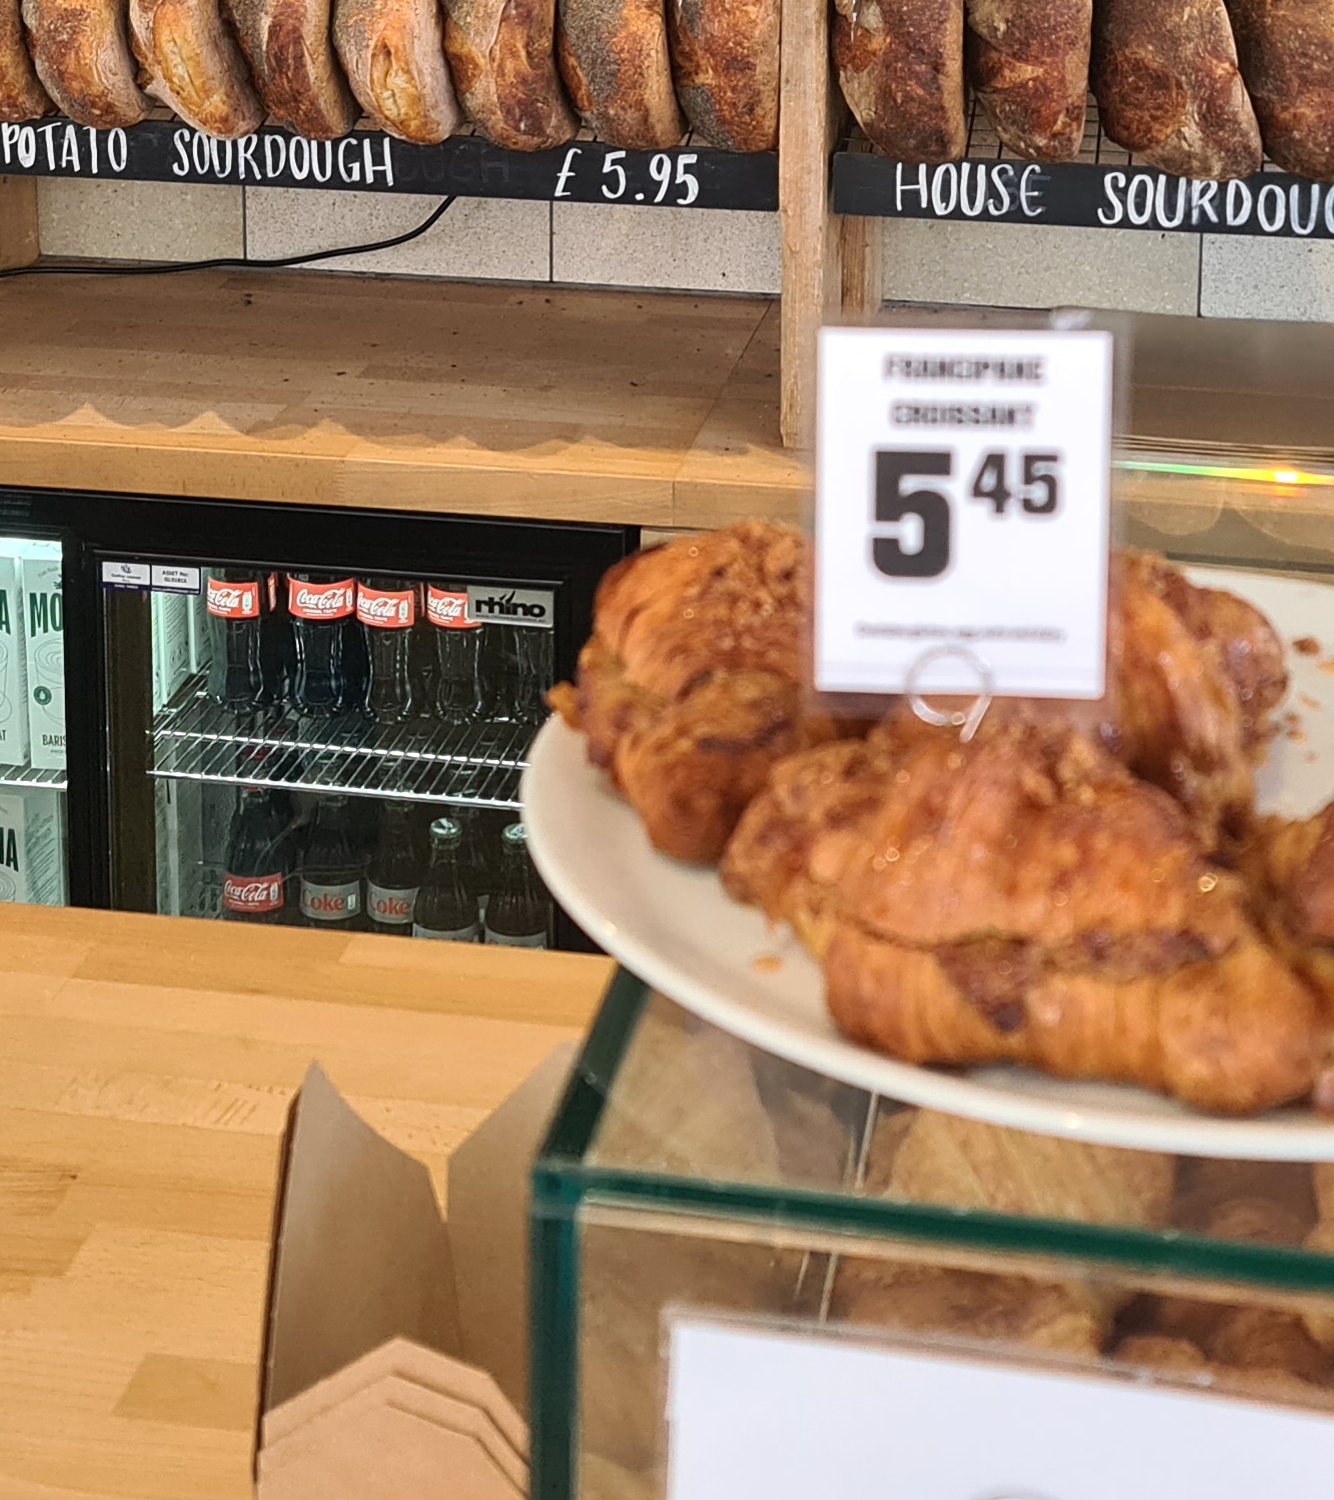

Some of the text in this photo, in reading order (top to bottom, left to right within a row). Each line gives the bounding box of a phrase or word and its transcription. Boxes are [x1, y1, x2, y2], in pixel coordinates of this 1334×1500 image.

[1, 120, 128, 173] POTATO
[172, 127, 395, 187] SOURDOUGH
[895, 161, 1044, 218] HOUSE
[29, 592, 64, 639] MO
[475, 590, 546, 618] rhino
[42, 734, 66, 747] BARIS
